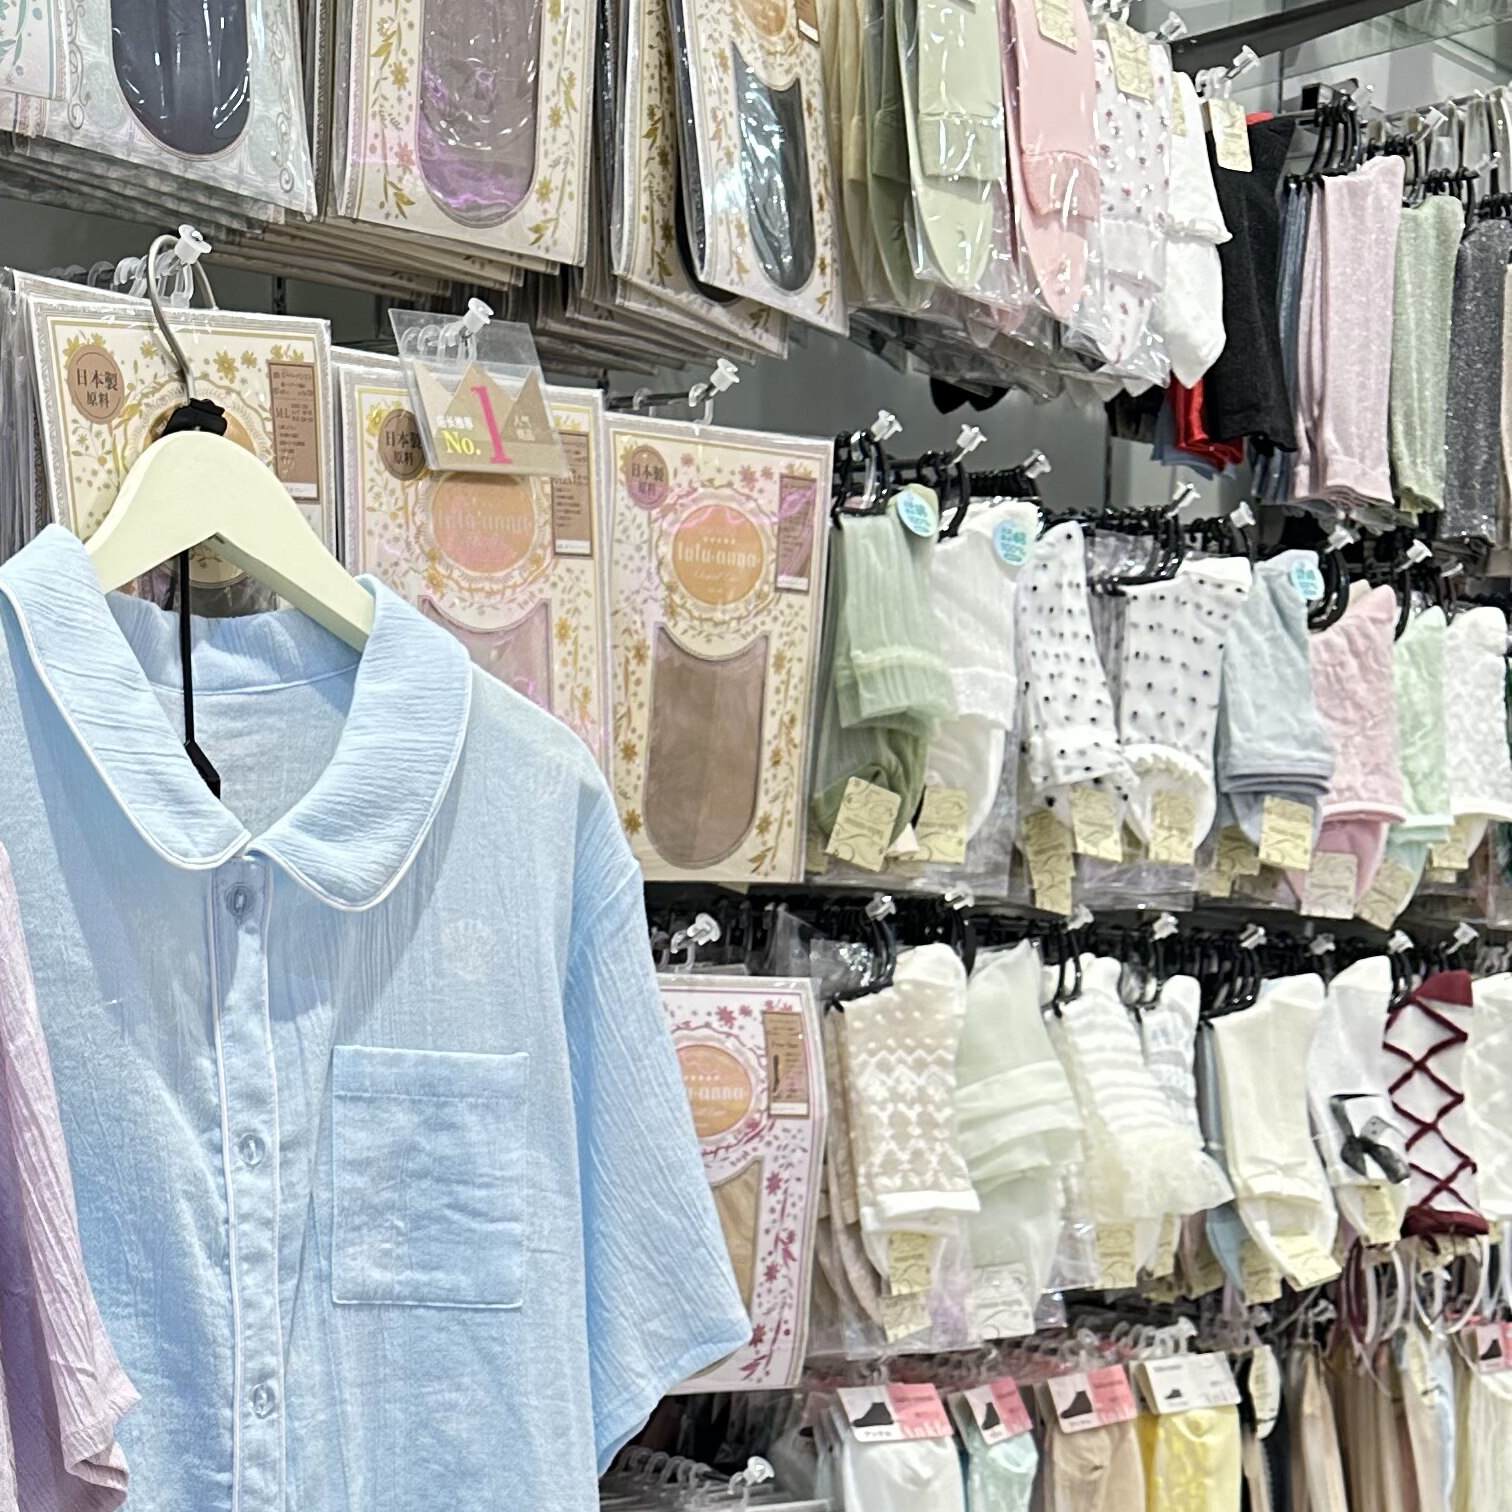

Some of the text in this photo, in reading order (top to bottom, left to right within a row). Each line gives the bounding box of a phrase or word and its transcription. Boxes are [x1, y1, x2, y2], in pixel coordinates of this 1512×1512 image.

[76, 367, 119, 392] 日本製
[441, 386, 514, 464] No. 1
